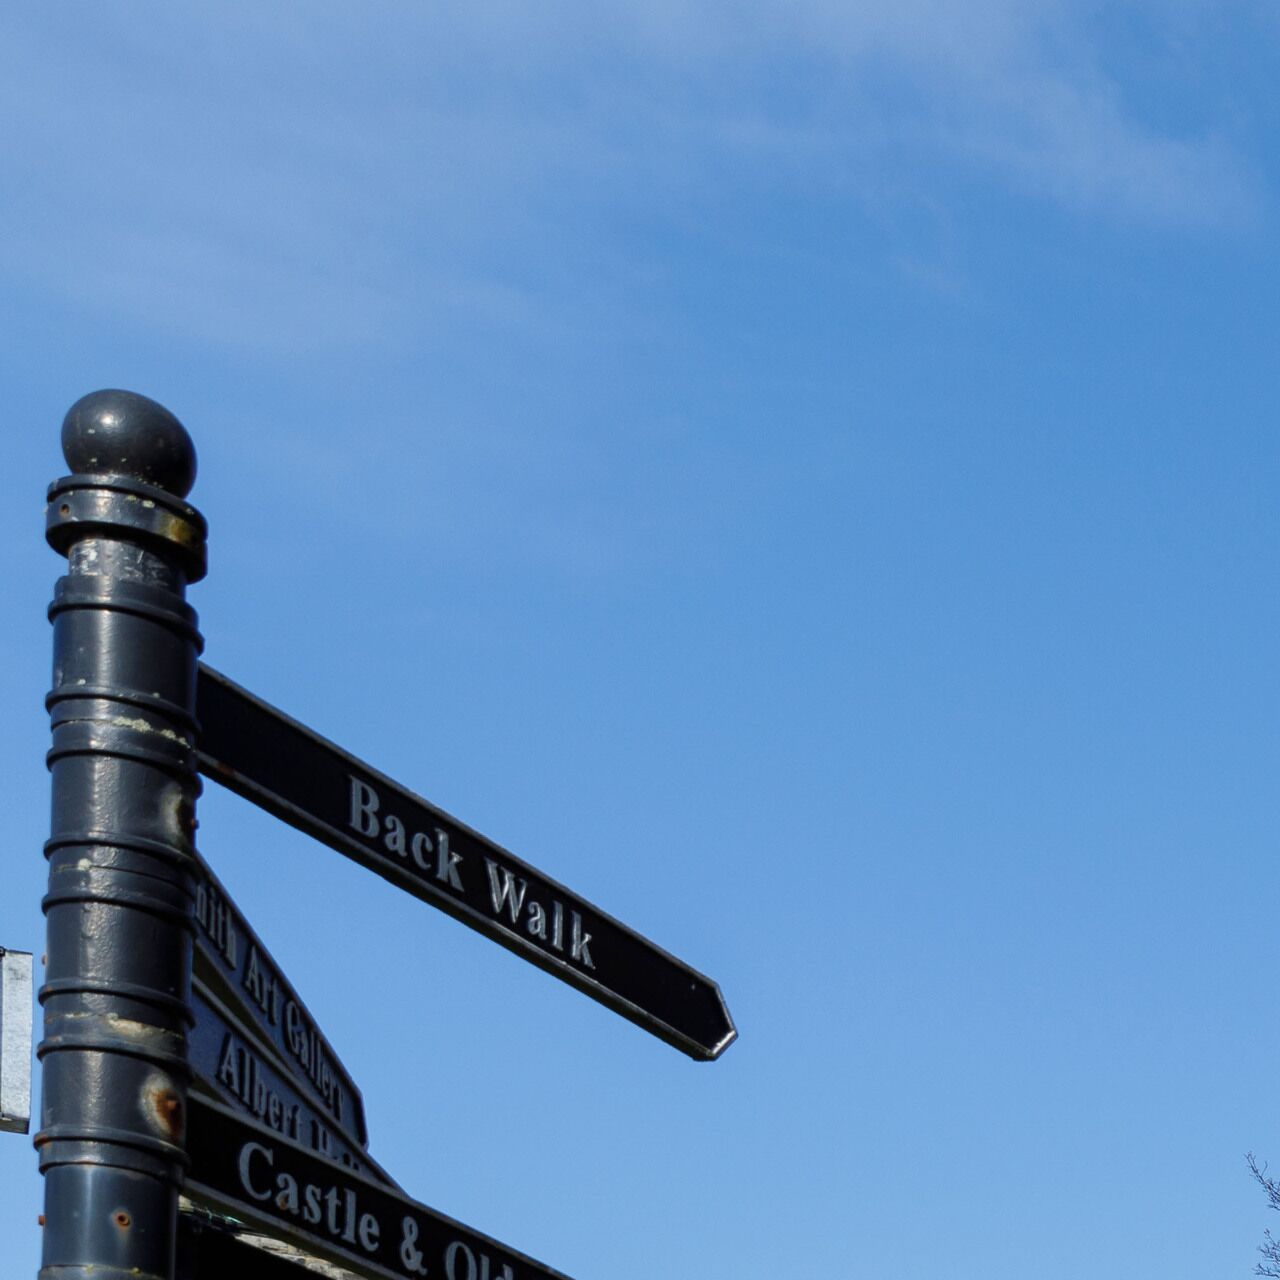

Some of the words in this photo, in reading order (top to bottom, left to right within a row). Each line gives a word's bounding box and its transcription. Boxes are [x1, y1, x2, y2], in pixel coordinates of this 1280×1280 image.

[349, 773, 465, 894] Back
[484, 856, 596, 970] Walk
[217, 1031, 301, 1141] Albert
[244, 944, 278, 1027] Art
[284, 1000, 344, 1124] Gallery
[238, 1141, 381, 1252] Castle
[400, 1215, 428, 1277] &
